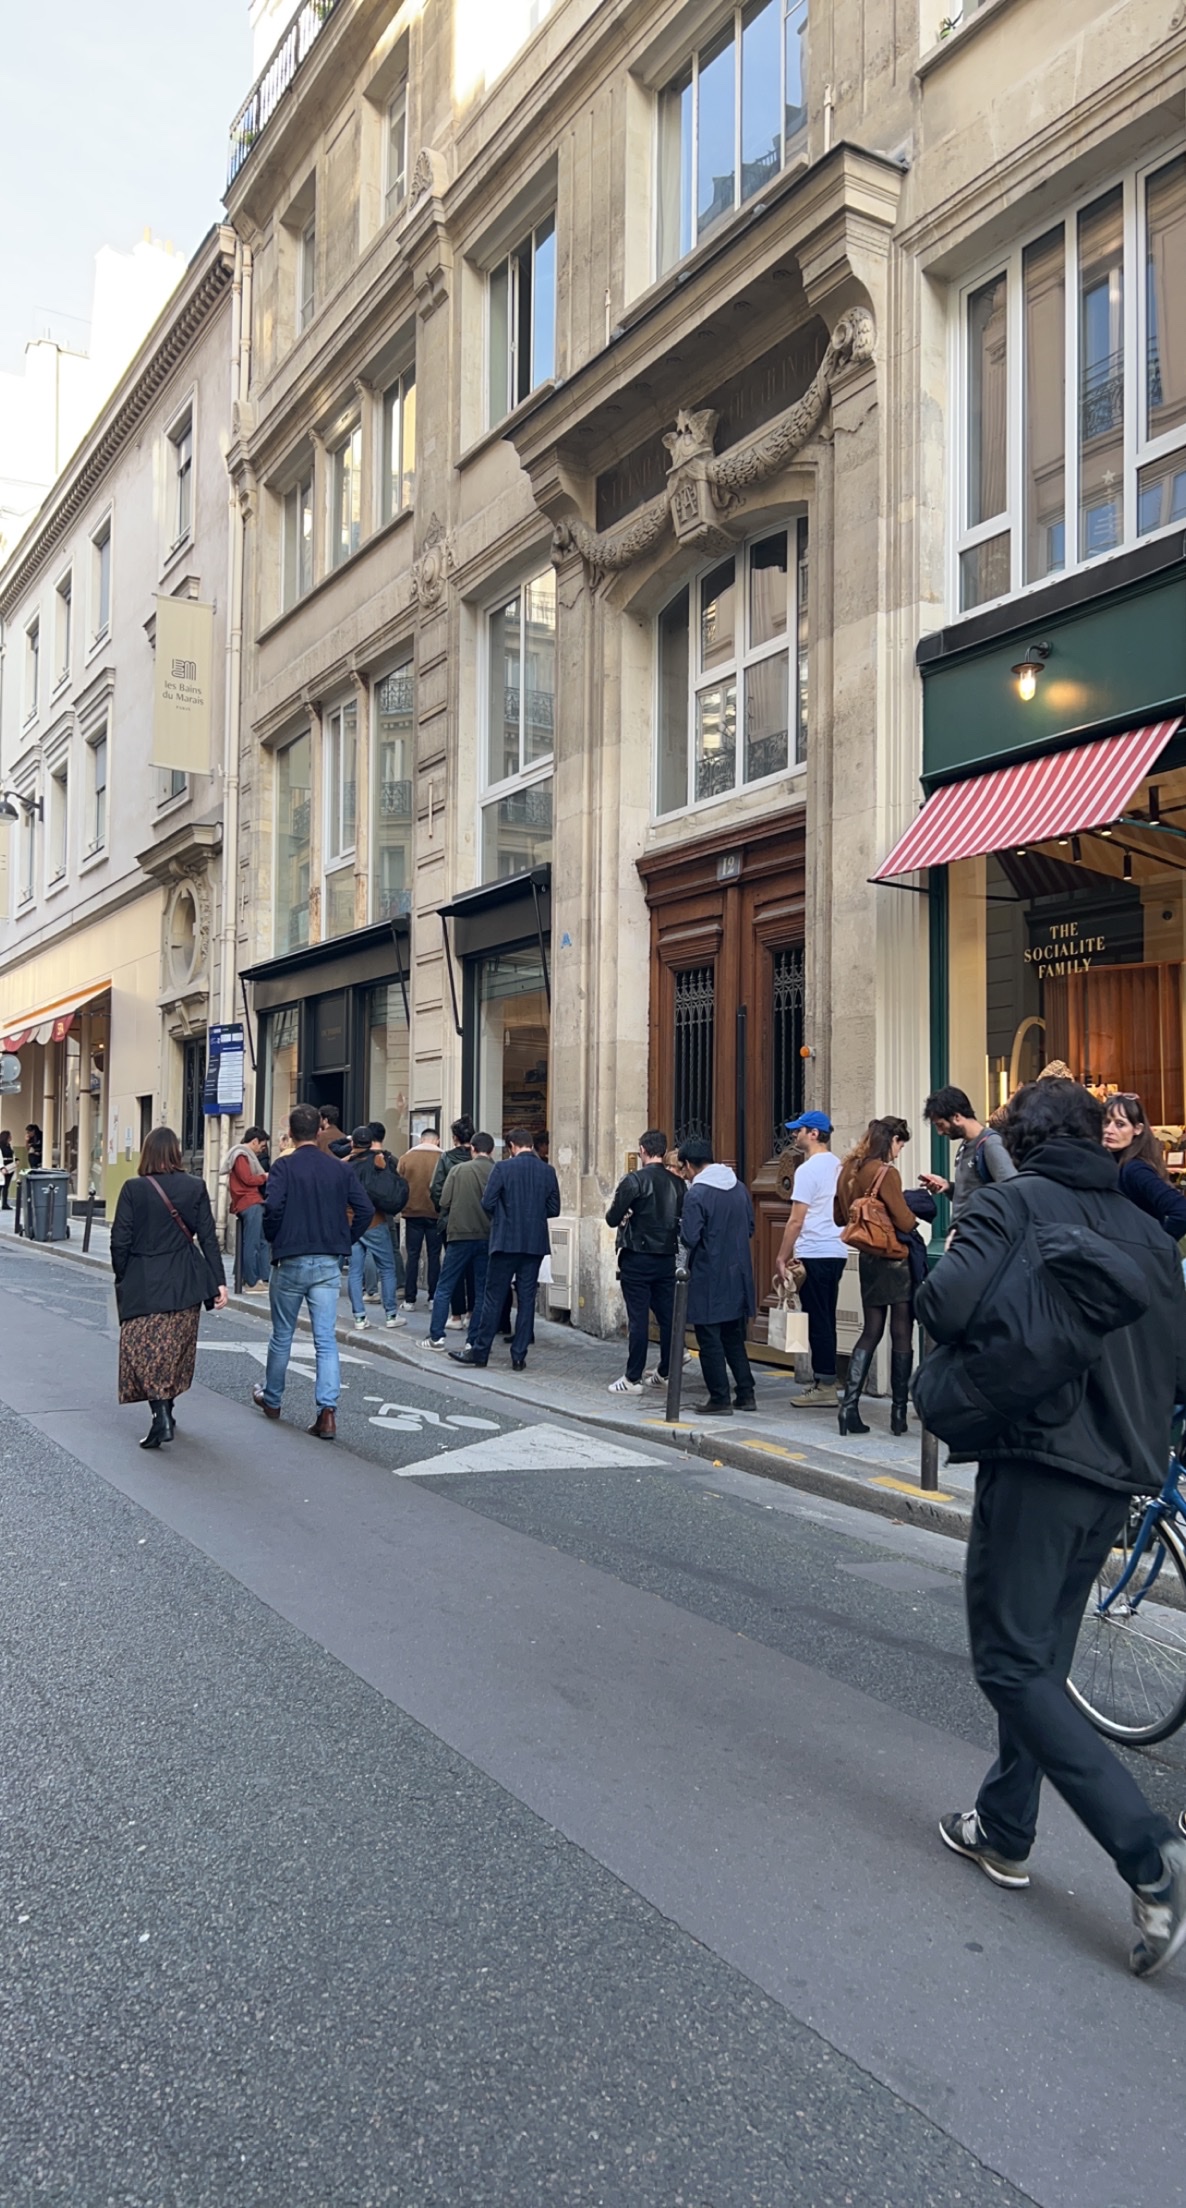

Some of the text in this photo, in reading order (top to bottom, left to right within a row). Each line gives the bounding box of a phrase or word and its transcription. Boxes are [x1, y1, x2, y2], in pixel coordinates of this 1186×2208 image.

[164, 680, 202, 695] les Bains
[162, 690, 204, 706] du Marais
[722, 856, 735, 876] 12
[1049, 921, 1079, 940] THE
[1023, 935, 1106, 963] SOCIALITE
[1038, 957, 1092, 979] FAMILY
